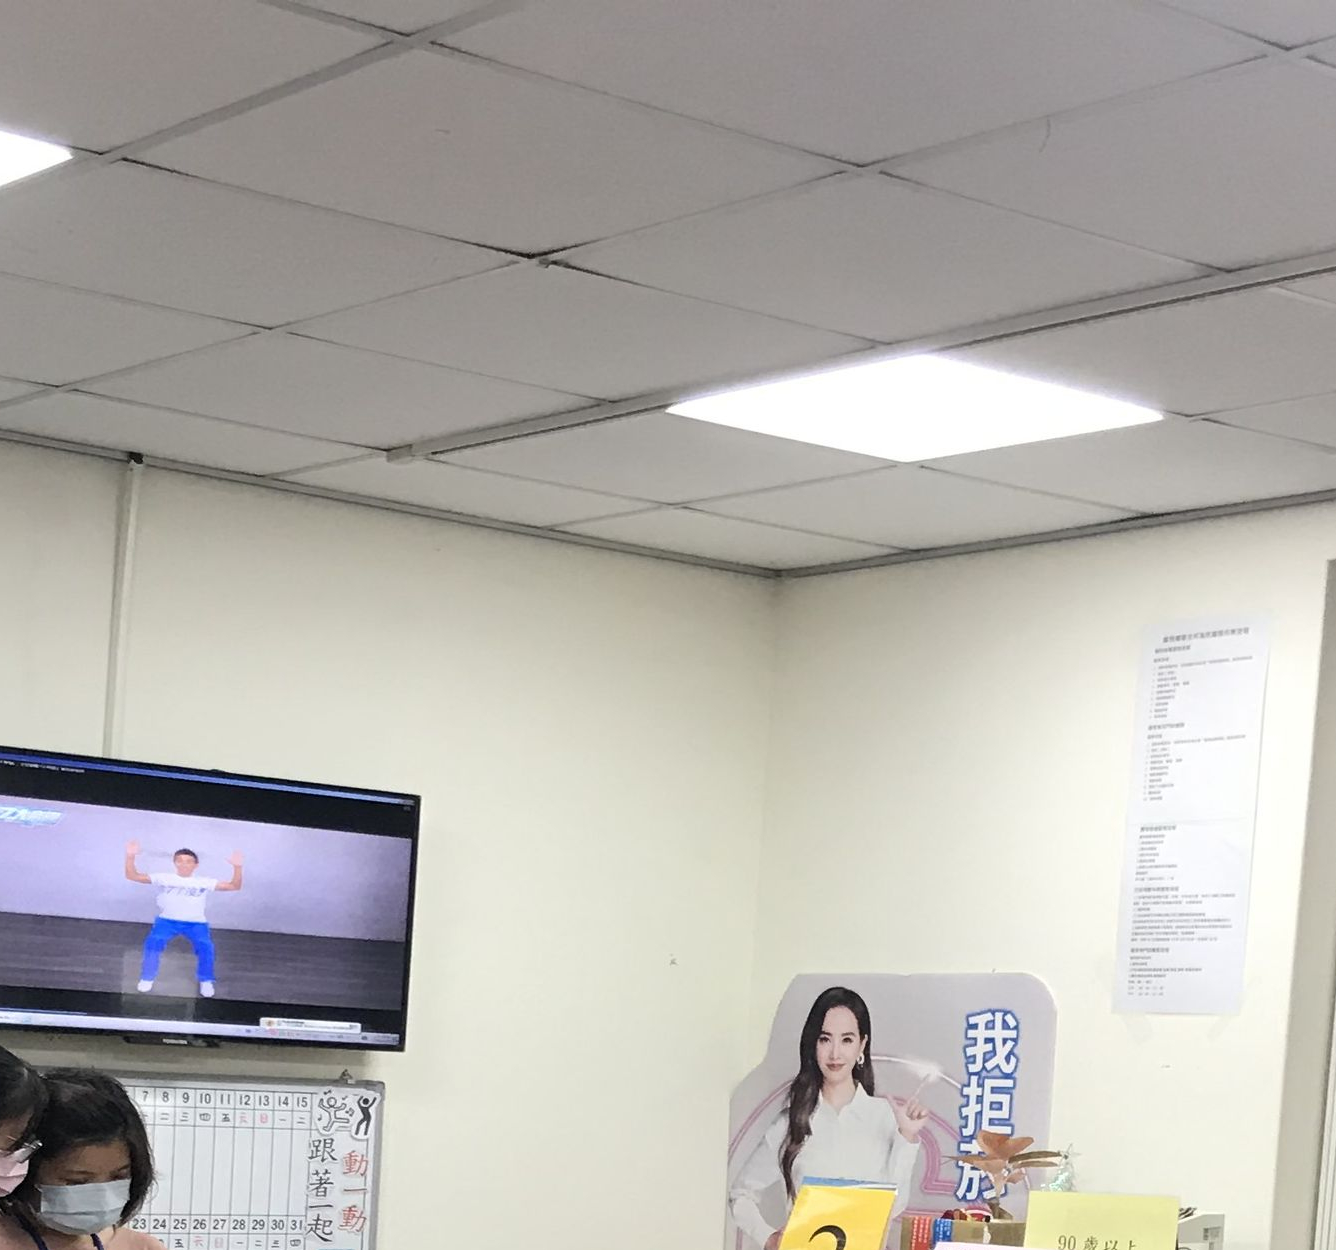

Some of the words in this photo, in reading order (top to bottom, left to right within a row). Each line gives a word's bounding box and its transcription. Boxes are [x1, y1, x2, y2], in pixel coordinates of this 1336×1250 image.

[143, 1091, 149, 1102] 7
[162, 1091, 169, 1102] 8
[182, 1092, 190, 1103] 9
[199, 1093, 211, 1104] 10
[220, 1094, 231, 1105] 11
[239, 1094, 251, 1106] 12
[258, 1095, 270, 1107] 13
[278, 1095, 289, 1107] 14
[297, 1096, 308, 1108] 15
[339, 1150, 369, 1233] 動一動
[132, 1218, 147, 1230] 23
[153, 1218, 166, 1230] 24
[173, 1218, 187, 1230] 25
[193, 1218, 207, 1230] 26
[213, 1218, 226, 1230] 27
[232, 1218, 246, 1230] 28
[251, 1218, 265, 1230] 29
[271, 1218, 284, 1230] 30
[290, 1218, 303, 1230] 31
